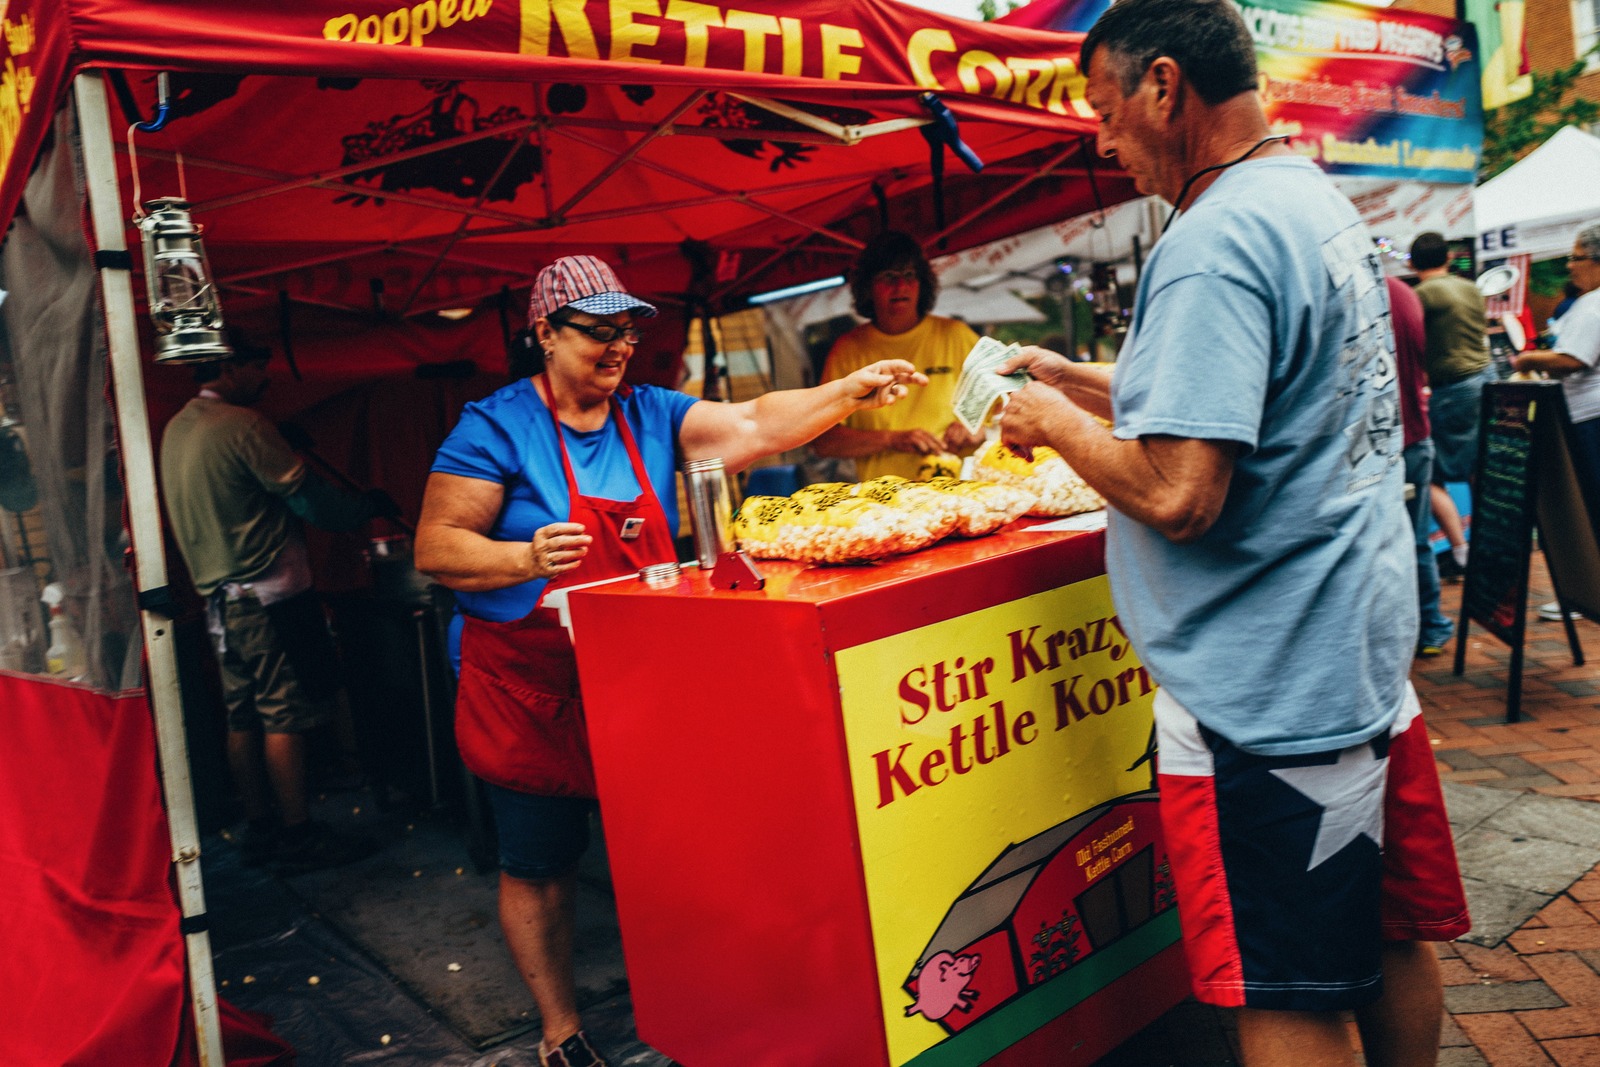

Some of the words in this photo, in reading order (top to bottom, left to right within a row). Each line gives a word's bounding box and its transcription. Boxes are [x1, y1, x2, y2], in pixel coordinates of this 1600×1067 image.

[322, 0, 493, 48] Popped
[519, 0, 864, 81] KETTLE
[898, 655, 995, 728] Stir
[1007, 614, 1131, 684] Krazy
[871, 702, 1039, 810] Kettle
[1075, 845, 1093, 867] Old
[1091, 815, 1135, 856] Fashioned
[1084, 855, 1112, 882] Kettle
[1110, 842, 1134, 863] Corn
